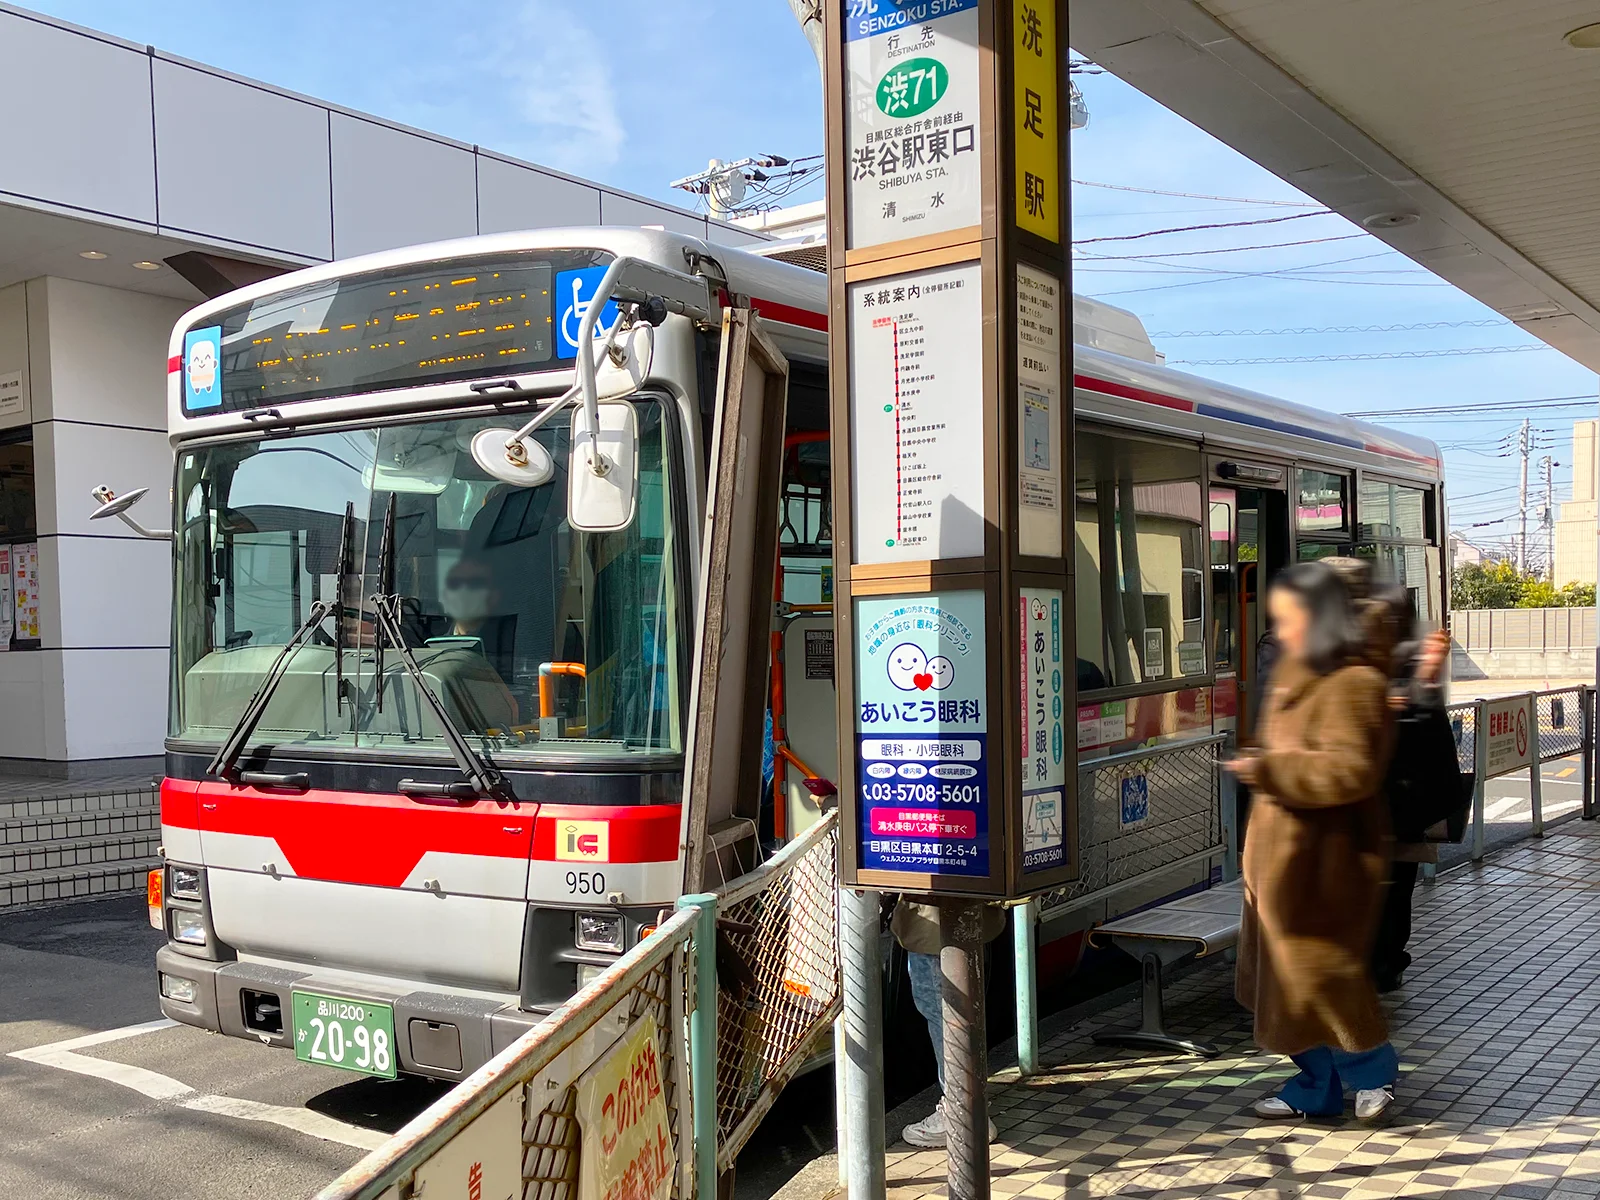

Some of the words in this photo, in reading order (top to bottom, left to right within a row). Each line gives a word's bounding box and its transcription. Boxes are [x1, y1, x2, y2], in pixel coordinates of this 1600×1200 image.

[859, 1, 927, 34] SENZOKU
[931, 0, 963, 14] STA.
[887, 25, 935, 50] 行先
[887, 39, 936, 59] DESTINATION
[883, 66, 938, 114] 渋71
[1021, 3, 1045, 221] 洗足駅
[866, 111, 964, 144] 目黒区総合庁舎前経由
[851, 124, 976, 182] 渋谷駅東口
[878, 172, 923, 190] SHIBUYA
[925, 168, 949, 181] STA.
[882, 191, 945, 219] 清水
[902, 212, 926, 223] SHIMIZU
[861, 699, 981, 723] あいこう眼科
[1034, 630, 1048, 782] あいこう眼科
[881, 743, 965, 758] 眼科・小児眼科
[872, 767, 891, 775] 白内障
[871, 783, 981, 804] 03-5708-5601
[870, 840, 943, 856] 目黒区目黒本町
[945, 844, 978, 857] 2-5-4
[565, 871, 606, 895] 950
[317, 1000, 365, 1022] 品川200
[298, 1028, 308, 1043] か
[309, 1017, 390, 1071] 20-98
